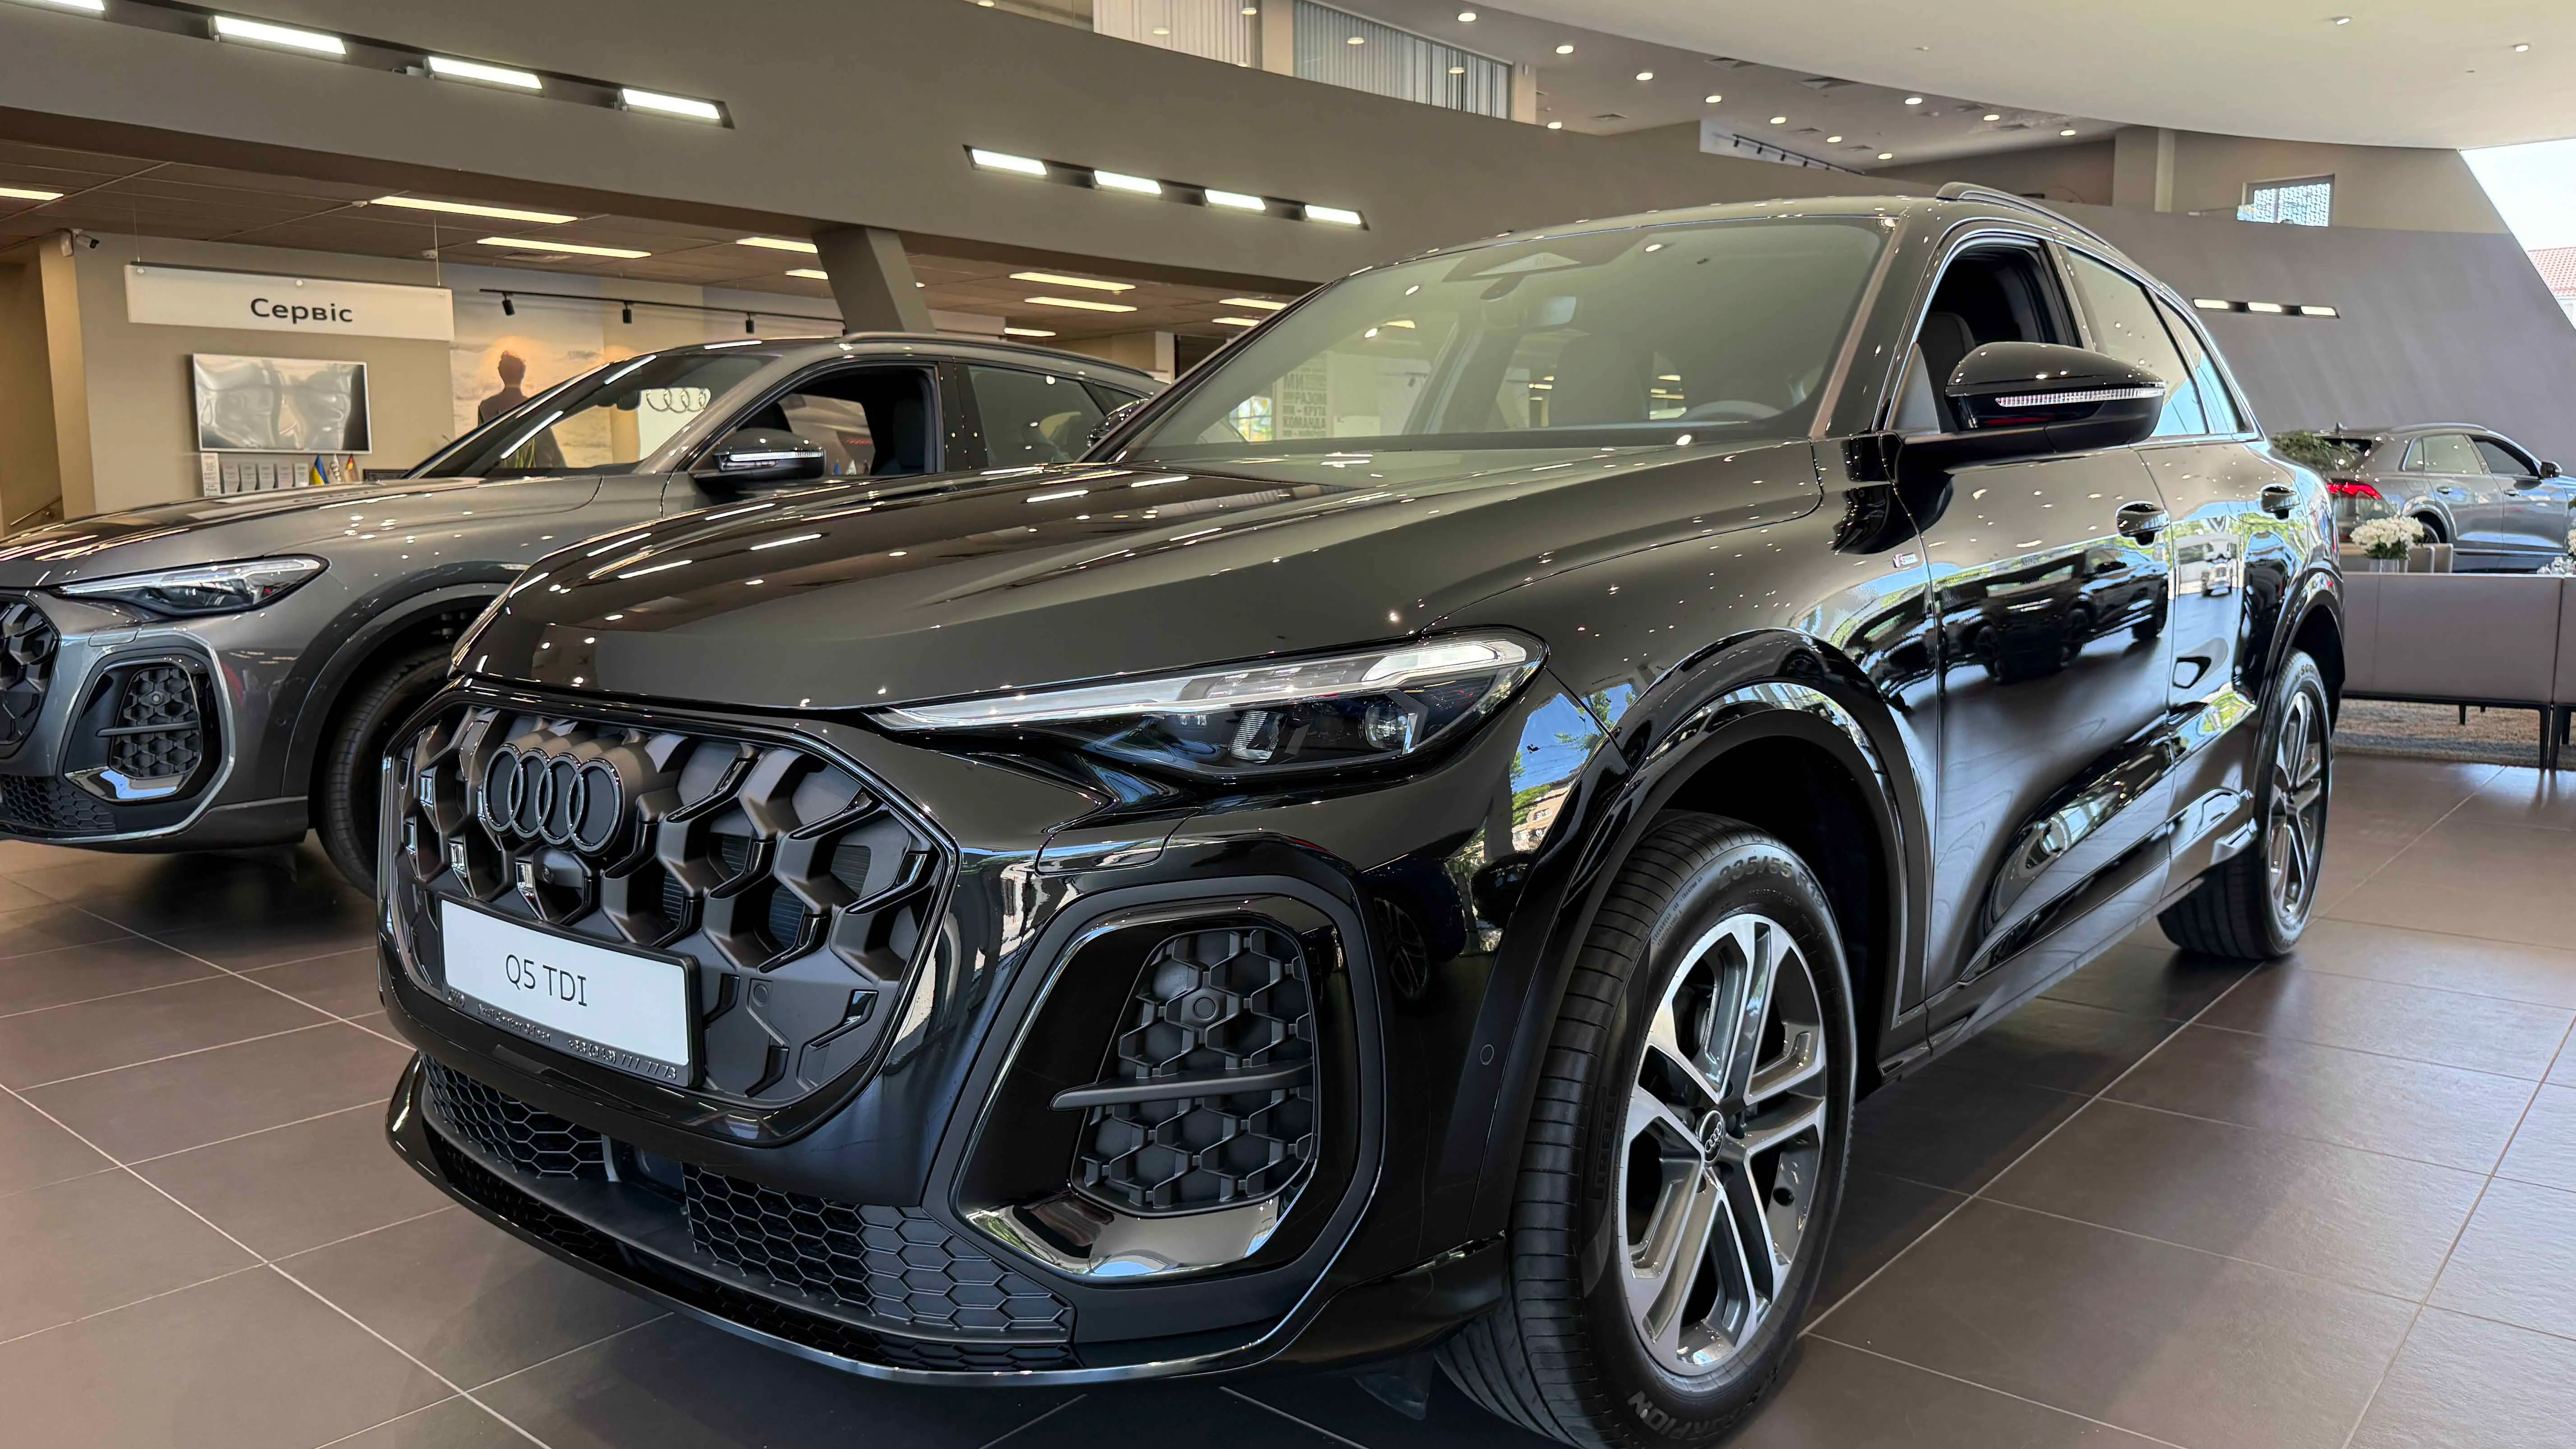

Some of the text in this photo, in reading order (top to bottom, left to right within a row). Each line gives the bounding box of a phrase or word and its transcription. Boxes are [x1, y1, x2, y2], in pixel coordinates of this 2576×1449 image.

[251, 298, 353, 324] Сервіс
[1719, 856, 1793, 890] 235/55
[506, 954, 588, 1007] Q5 TDI
